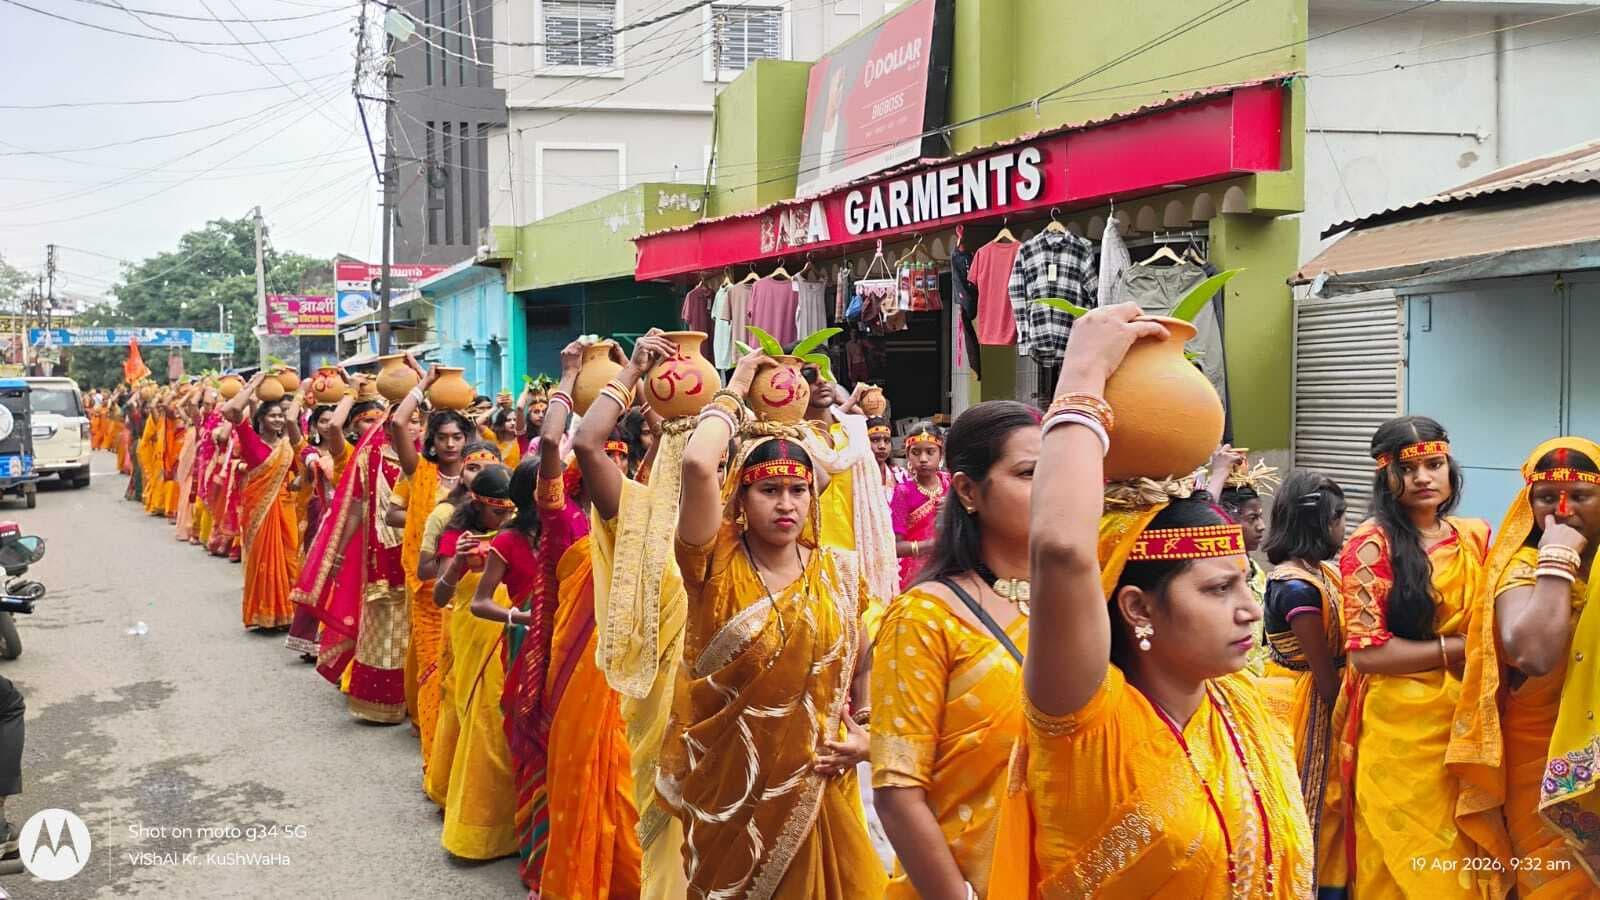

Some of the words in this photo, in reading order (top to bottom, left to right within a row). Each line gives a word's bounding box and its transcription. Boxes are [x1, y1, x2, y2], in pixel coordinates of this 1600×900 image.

[874, 38, 922, 81] DOLLAR
[871, 92, 905, 120] BIGBOSS
[844, 147, 1042, 235] GARMENTS
[766, 465, 788, 476] जय
[1192, 536, 1231, 552] जय
